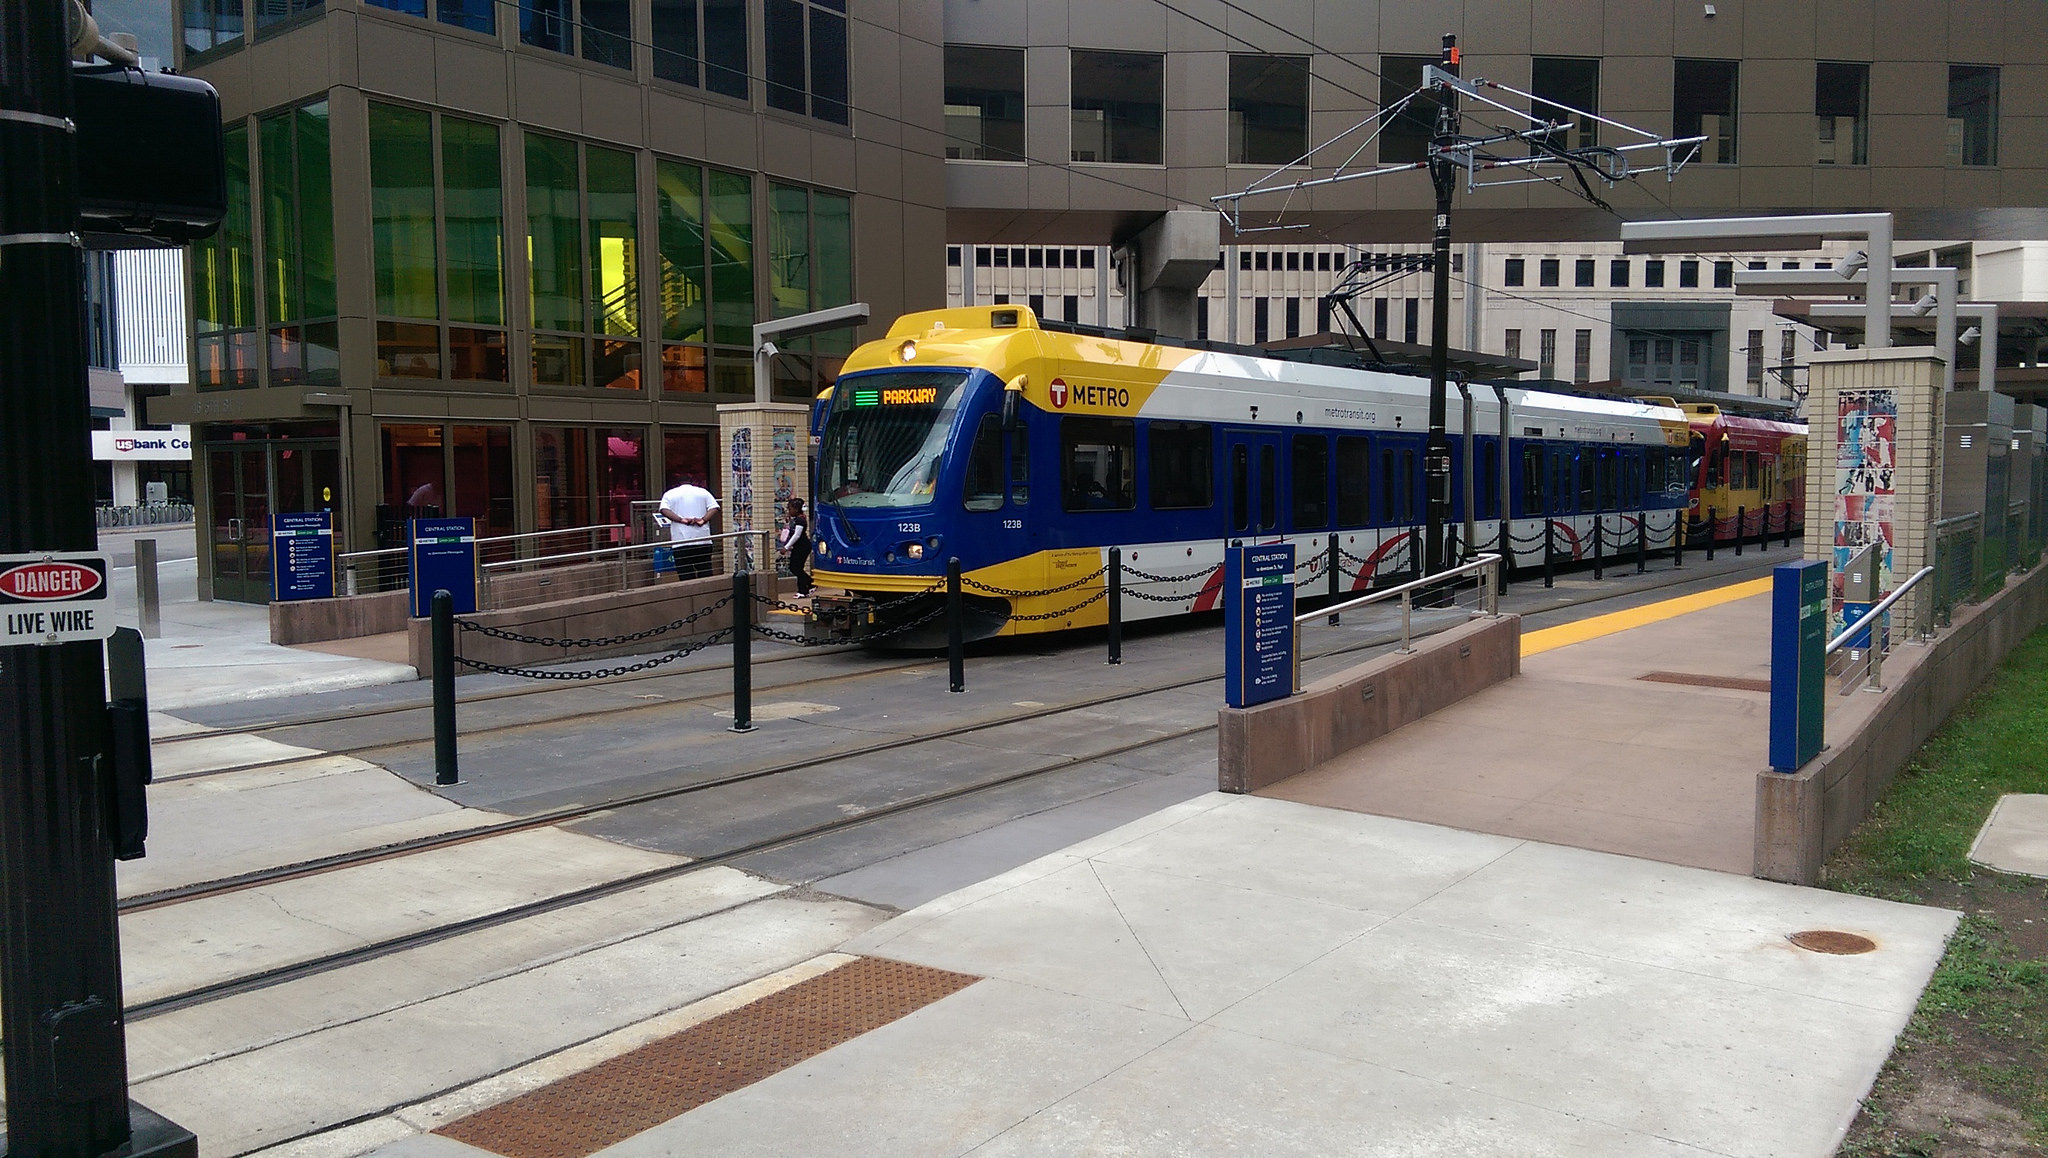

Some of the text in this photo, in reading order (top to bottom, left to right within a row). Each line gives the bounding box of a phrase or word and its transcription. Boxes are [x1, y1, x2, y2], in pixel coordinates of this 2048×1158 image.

[883, 387, 937, 405] PARKWAY
[1073, 385, 1130, 408] METRO
[1325, 408, 1376, 424] metrotransit.org
[898, 523, 921, 532] 123B
[1003, 519, 1022, 529] 123B
[1251, 553, 1288, 563] CENTRAL STATION
[14, 570, 83, 593] DANGER
[8, 610, 94, 635] LIVE WIRE
